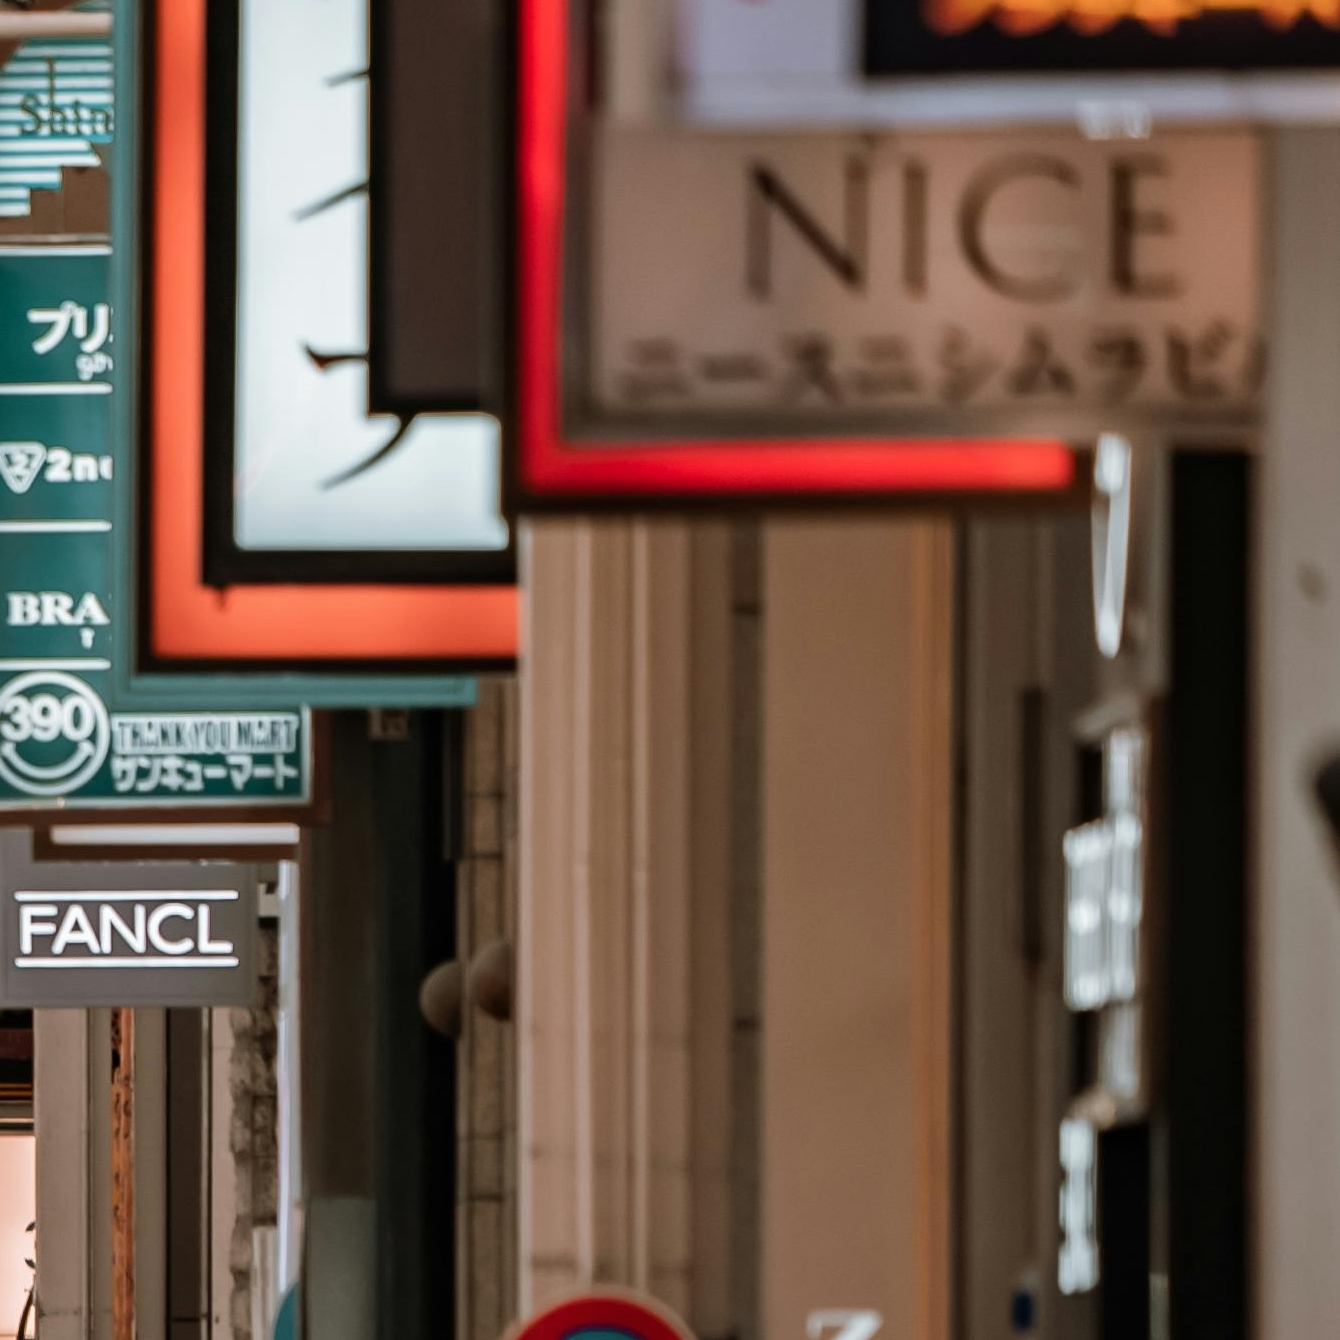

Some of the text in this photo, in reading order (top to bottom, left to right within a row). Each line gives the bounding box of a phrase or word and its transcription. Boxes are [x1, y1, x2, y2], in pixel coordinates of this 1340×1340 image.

[747, 149, 1182, 302] NICE
[27, 299, 113, 355] プリ
[6, 590, 111, 627] BRA
[0, 693, 95, 742] 390
[19, 902, 234, 955] FANCL
